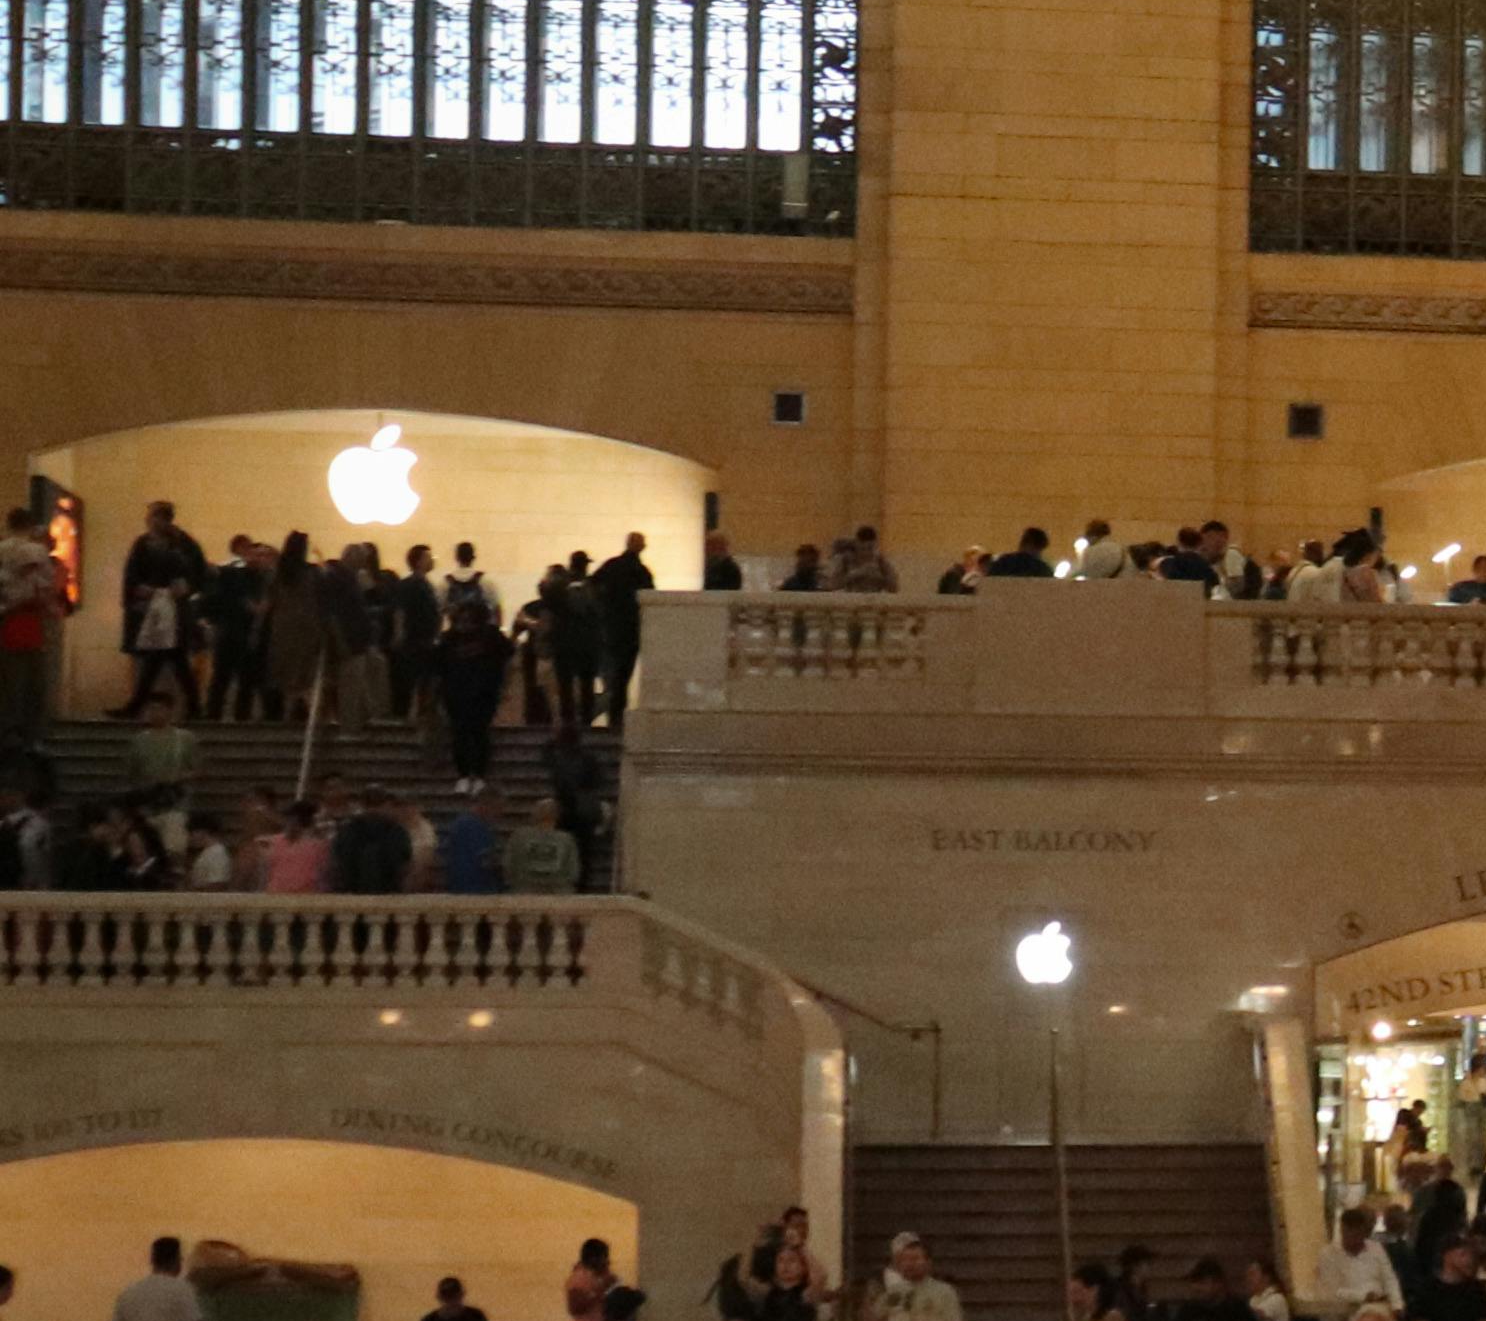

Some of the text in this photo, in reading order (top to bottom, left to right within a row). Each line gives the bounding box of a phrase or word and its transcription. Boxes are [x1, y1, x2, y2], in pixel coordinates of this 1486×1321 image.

[930, 829, 1158, 852] EAST BALCONY
[1346, 976, 1431, 1014] 42ND
